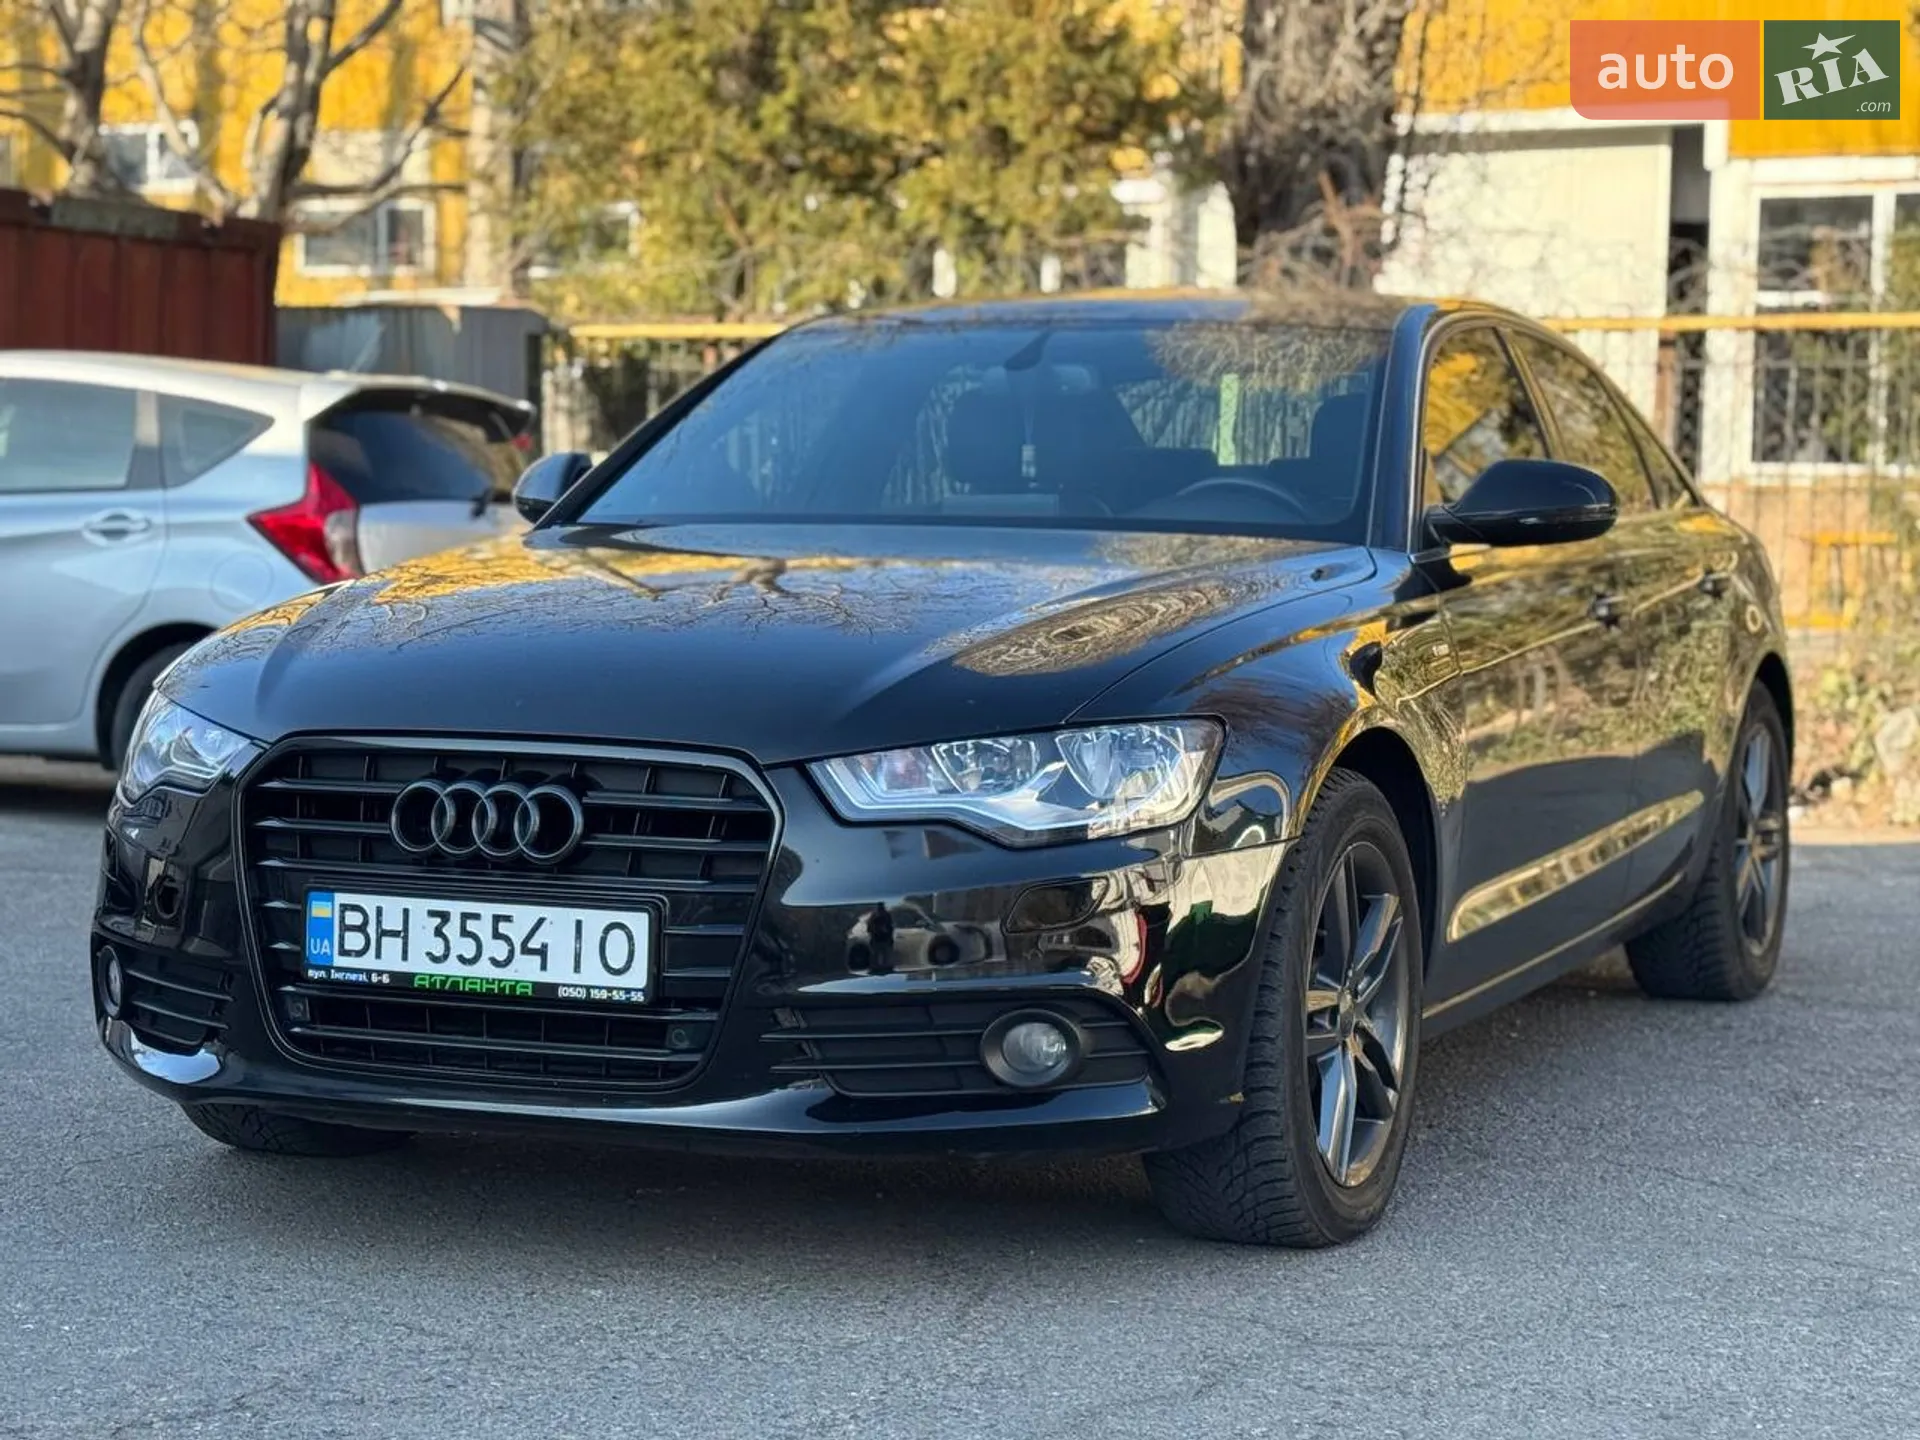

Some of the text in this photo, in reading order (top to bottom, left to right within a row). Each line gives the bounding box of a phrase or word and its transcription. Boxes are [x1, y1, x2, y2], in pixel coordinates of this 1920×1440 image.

[310, 937, 331, 957] UA
[337, 902, 410, 962] BH
[424, 909, 549, 972] 3554
[413, 974, 533, 996] АТЛАНТА
[557, 985, 587, 999] (050)
